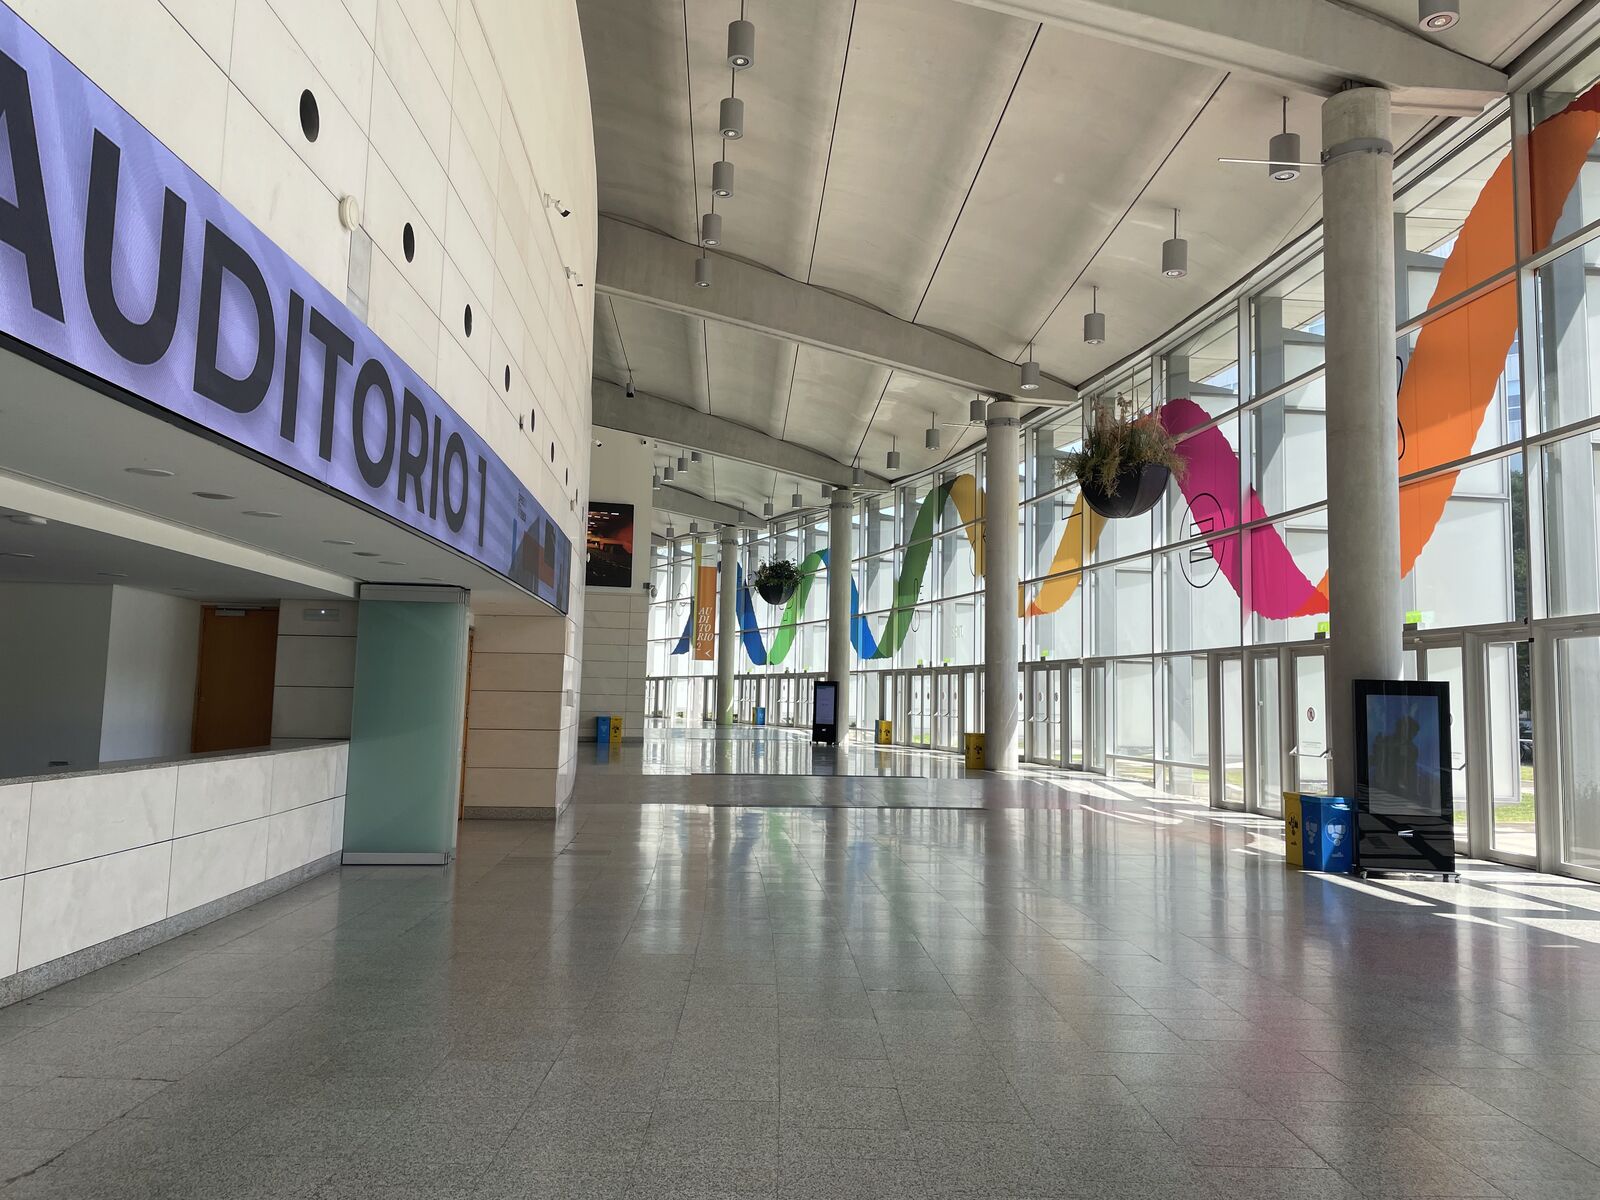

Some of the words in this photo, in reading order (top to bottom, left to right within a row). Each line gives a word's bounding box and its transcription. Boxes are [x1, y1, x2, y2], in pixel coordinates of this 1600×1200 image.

[0, 50, 469, 534] AUDITORIO
[478, 454, 487, 548] 1
[699, 607, 712, 615] AU
[698, 616, 710, 624] DI
[699, 624, 712, 632] TO
[697, 633, 714, 641] RIO
[697, 642, 702, 650] 2
